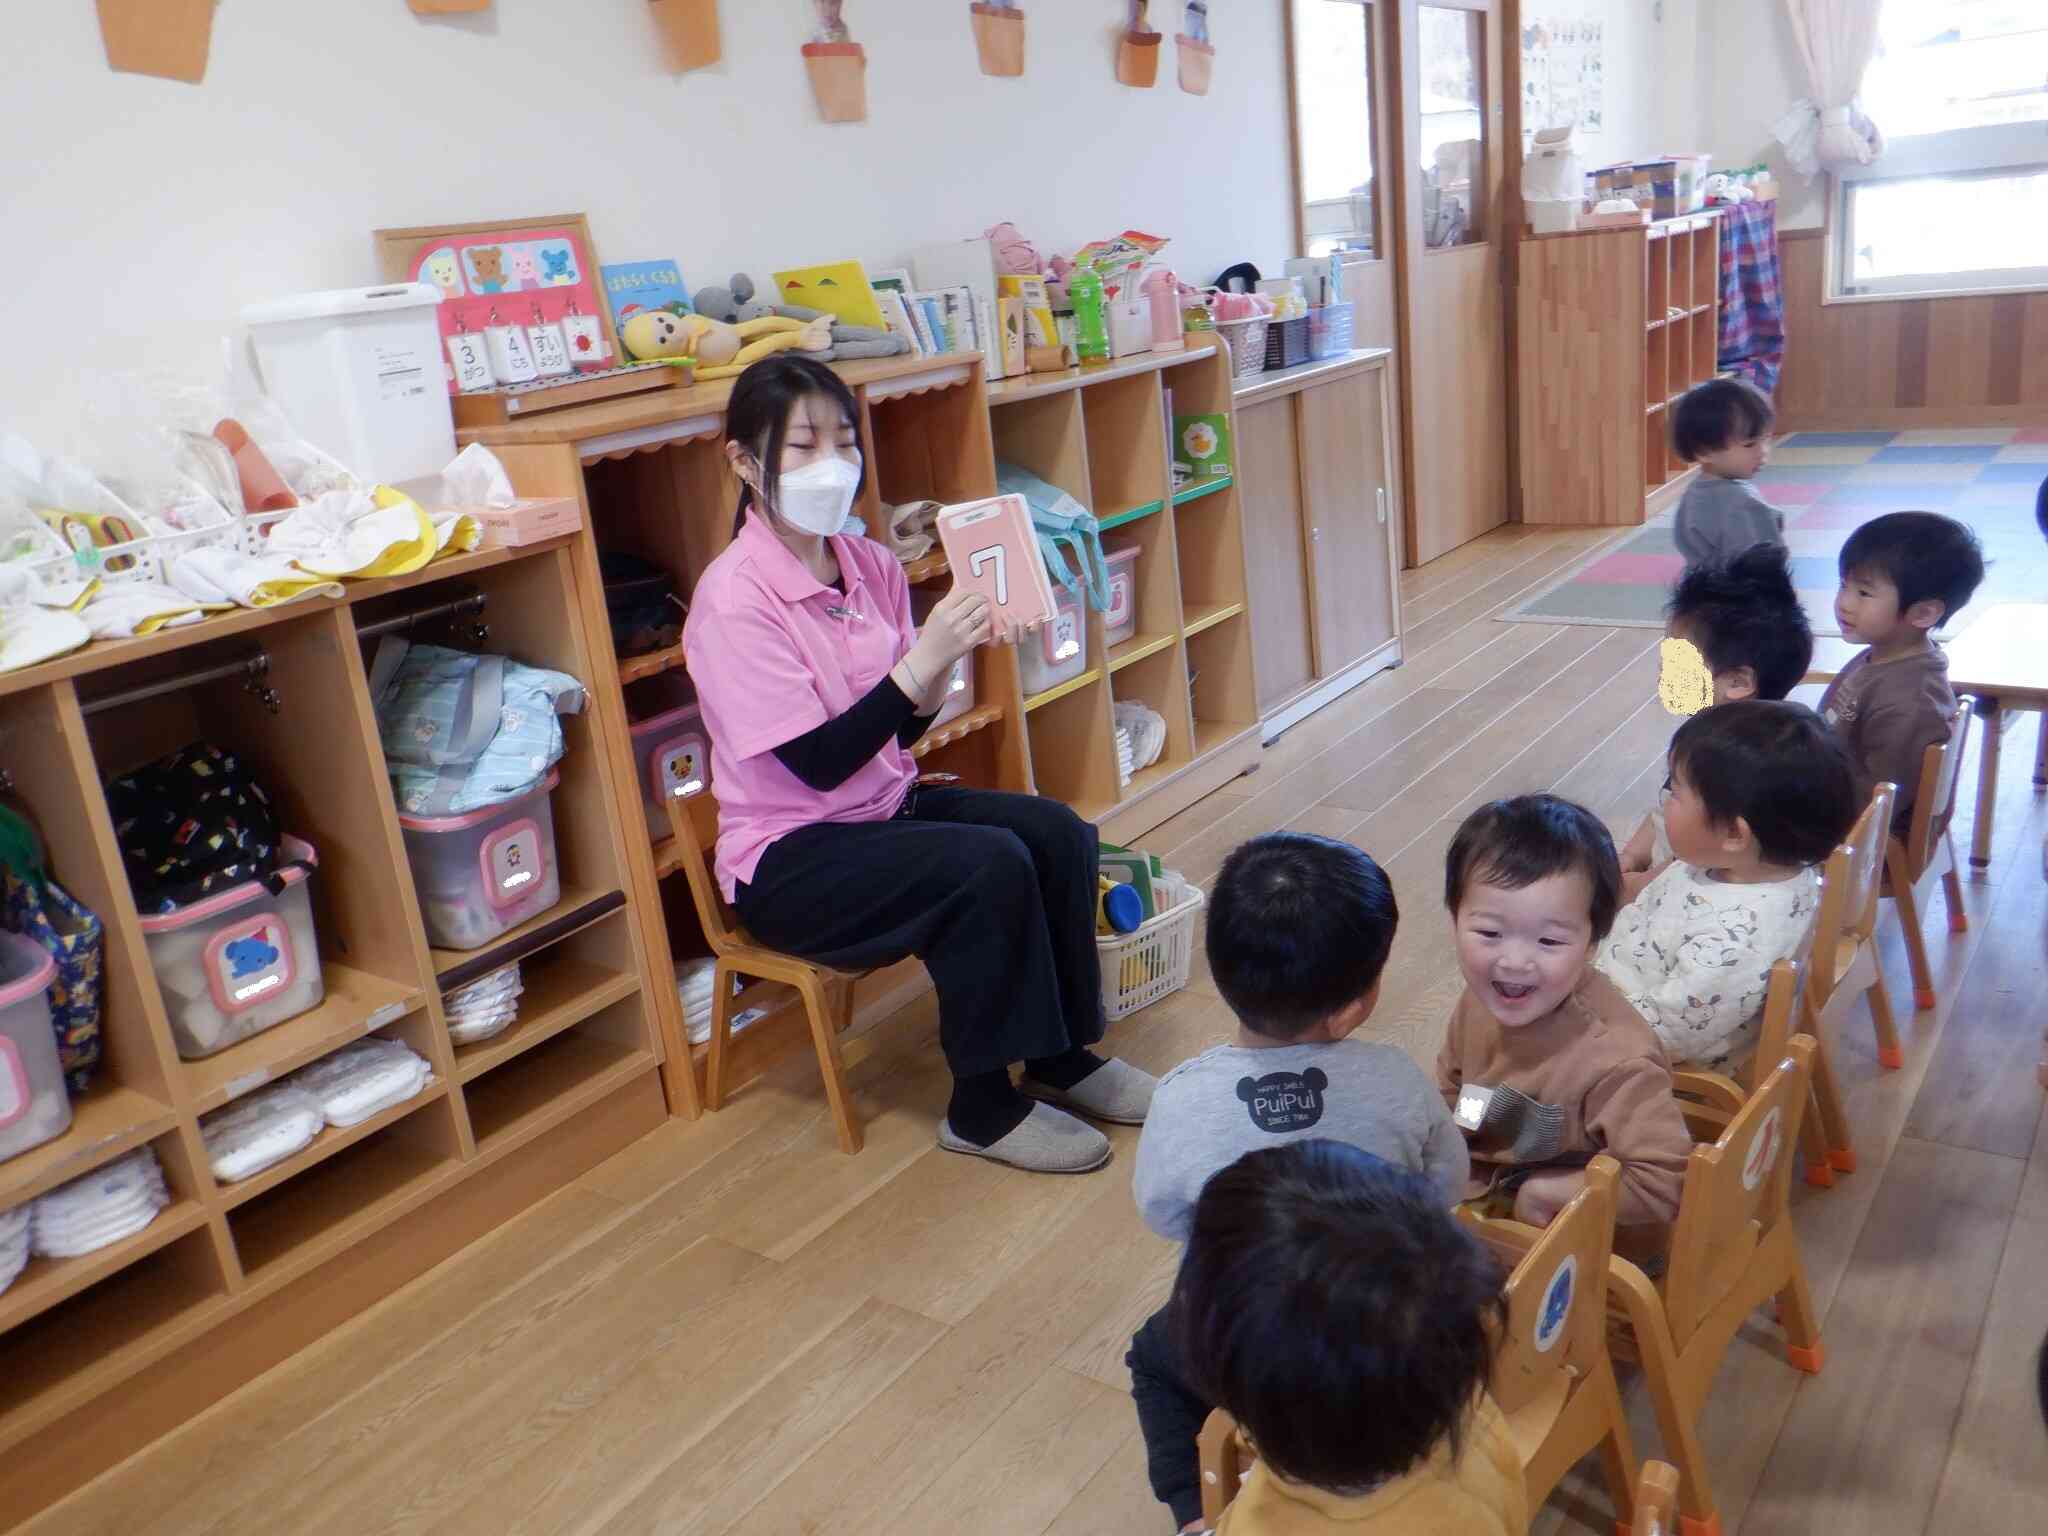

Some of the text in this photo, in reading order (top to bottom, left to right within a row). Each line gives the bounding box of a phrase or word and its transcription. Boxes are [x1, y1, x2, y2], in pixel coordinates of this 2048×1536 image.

[461, 345, 476, 364] 3
[508, 336, 520, 353] 4
[968, 543, 1009, 606] 7
[1254, 1089, 1316, 1116] PuiPui
